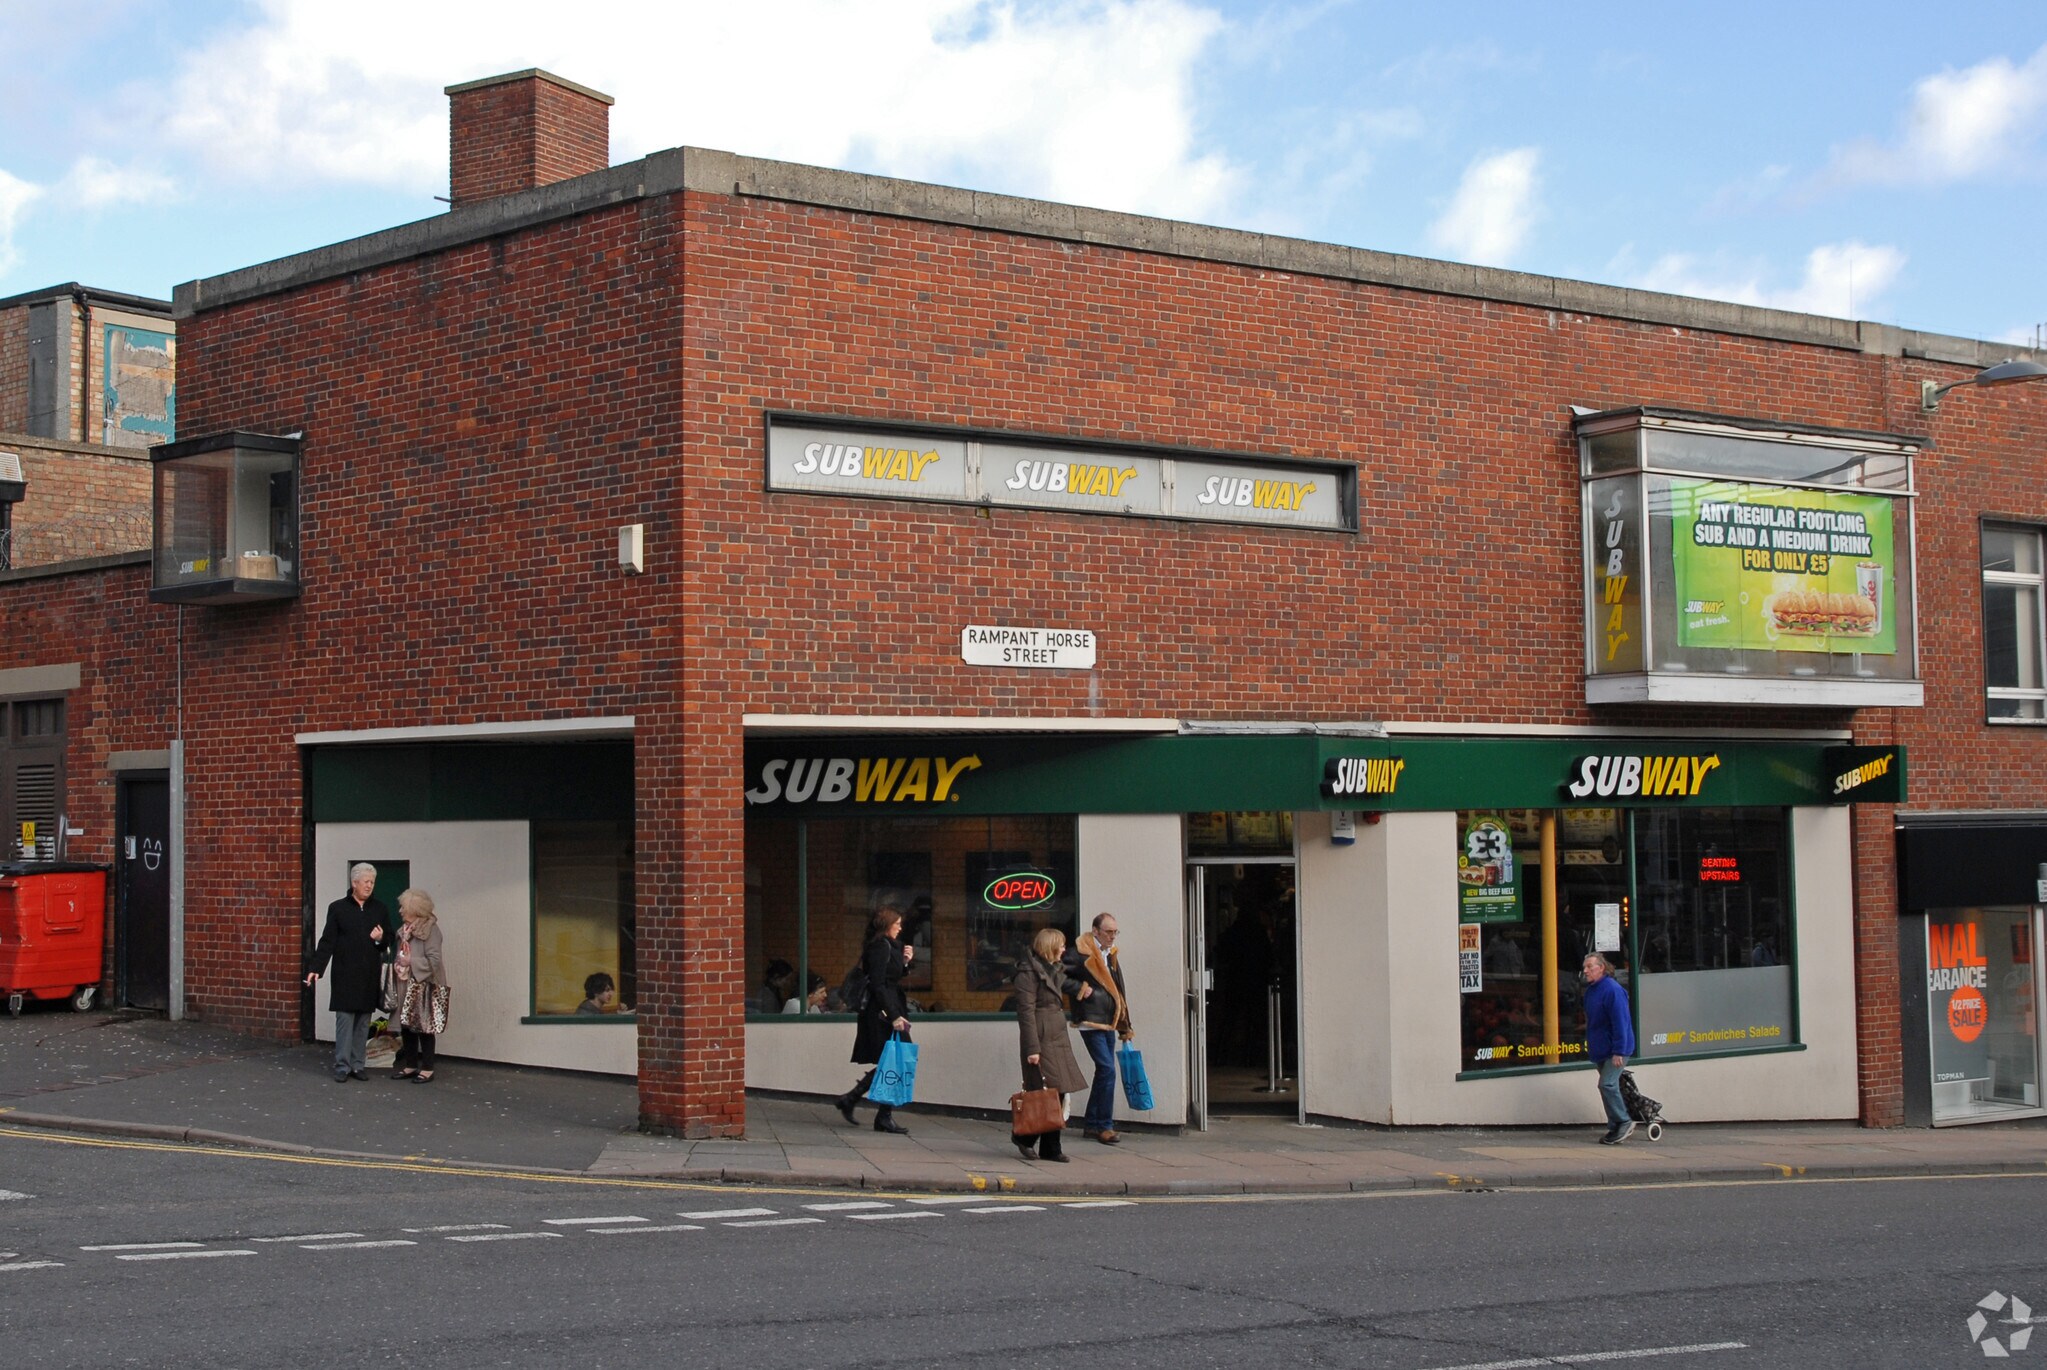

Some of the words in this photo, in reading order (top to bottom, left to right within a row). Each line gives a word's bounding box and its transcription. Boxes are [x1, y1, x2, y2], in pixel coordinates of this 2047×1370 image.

[793, 442, 941, 482] SUBWAY
[1005, 459, 1138, 497] SUBWAY
[1196, 475, 1317, 511] SUBWAY
[1701, 503, 1730, 523] ANY
[1733, 505, 1796, 528] REGULAR
[1799, 511, 1865, 534] FOOTLONG
[1695, 524, 1724, 544] SUB
[1727, 527, 1757, 547] AND
[1759, 530, 1769, 548] A
[1772, 531, 1827, 552] MEDIUM
[1830, 534, 1872, 555] DRINK
[1744, 549, 1771, 570] FOR
[1774, 552, 1807, 571] ONLY
[1810, 554, 1828, 573] £5
[1604, 489, 1629, 661] SUBWAY
[1684, 600, 1725, 614] SUBWAY
[1690, 618, 1704, 629] eat
[969, 629, 1039, 646] RAMPANT
[1046, 632, 1089, 648] HORSE
[1003, 648, 1058, 663] STREET
[745, 753, 983, 805] SUBWAY
[1332, 758, 1404, 795] SUBWAY
[1569, 753, 1720, 798] SUBWAY
[1833, 753, 1894, 795] SUBWAY
[1468, 830, 1507, 859] £3
[1702, 857, 1737, 868] SEATING
[1700, 870, 1740, 881] UPSTAIRS
[994, 881, 1048, 899] OPEN
[1479, 888, 1488, 896] BIG
[1488, 888, 1501, 896] BEEF
[1501, 887, 1514, 895] MELT
[1462, 938, 1476, 949] TAX
[1471, 951, 1479, 959] NO
[1460, 974, 1479, 988] TAX
[1963, 998, 1981, 1010] PRICE
[1952, 1009, 1981, 1027] SALE
[1650, 1031, 1686, 1045] SUBWAY
[1689, 1029, 1746, 1043] Sandwiches
[1749, 1025, 1780, 1038] Salads
[1474, 1045, 1514, 1060] SUBWAY
[1517, 1042, 1580, 1057] Sandwiches
[1937, 1071, 1965, 1081] TOPMAN
